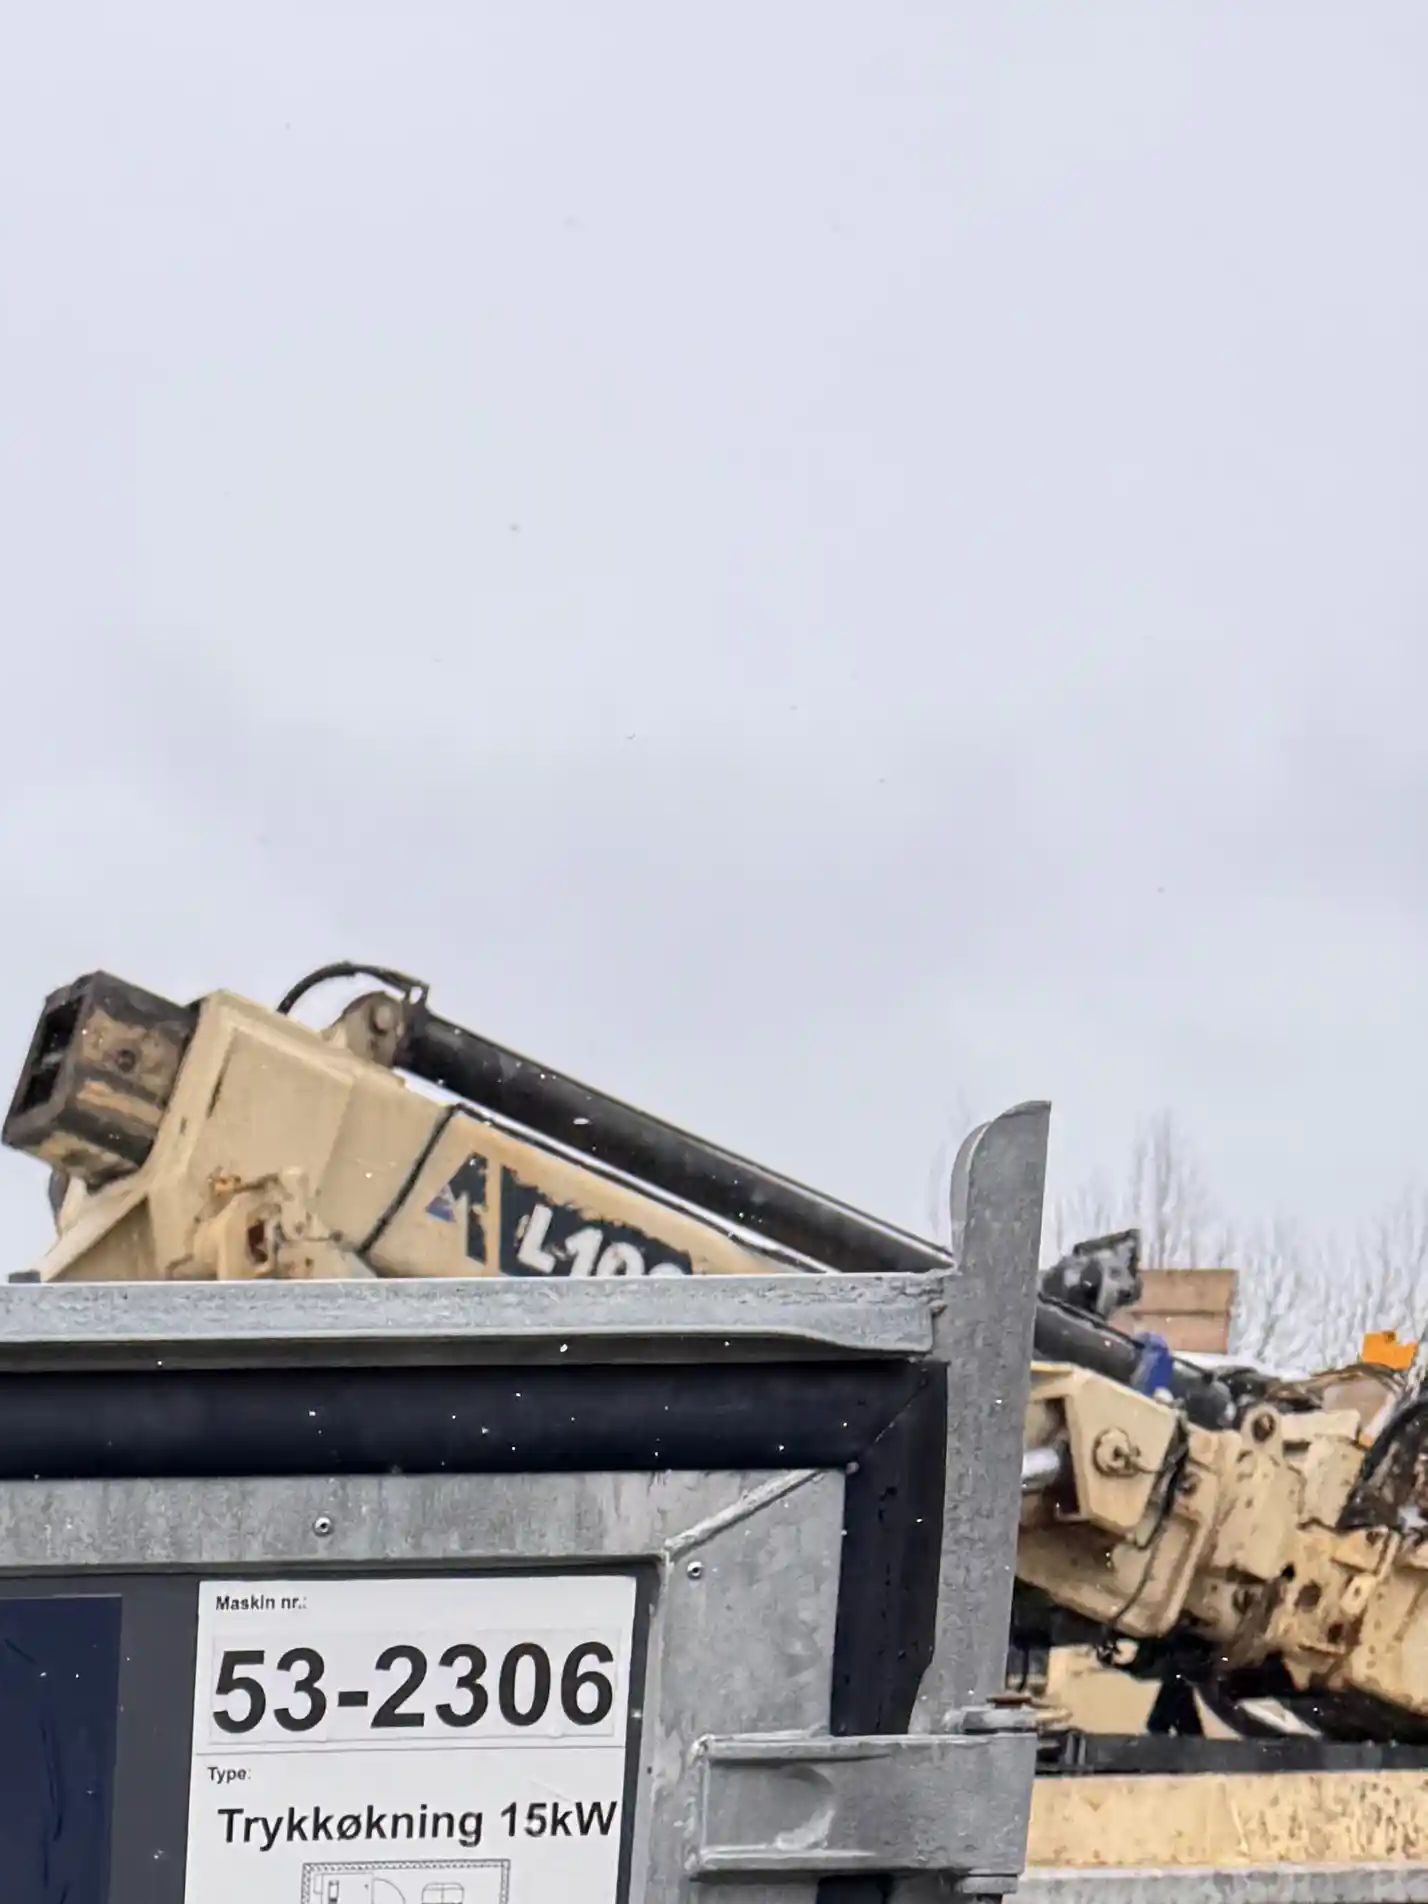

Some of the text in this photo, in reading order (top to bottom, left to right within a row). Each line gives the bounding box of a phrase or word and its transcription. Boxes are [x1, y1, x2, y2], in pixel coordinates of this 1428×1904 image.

[215, 1594, 276, 1611] Maskin
[212, 1641, 614, 1734] 53-2306
[207, 1766, 251, 1785] Type:
[217, 1800, 617, 1852] Trykkøkning 15kW
